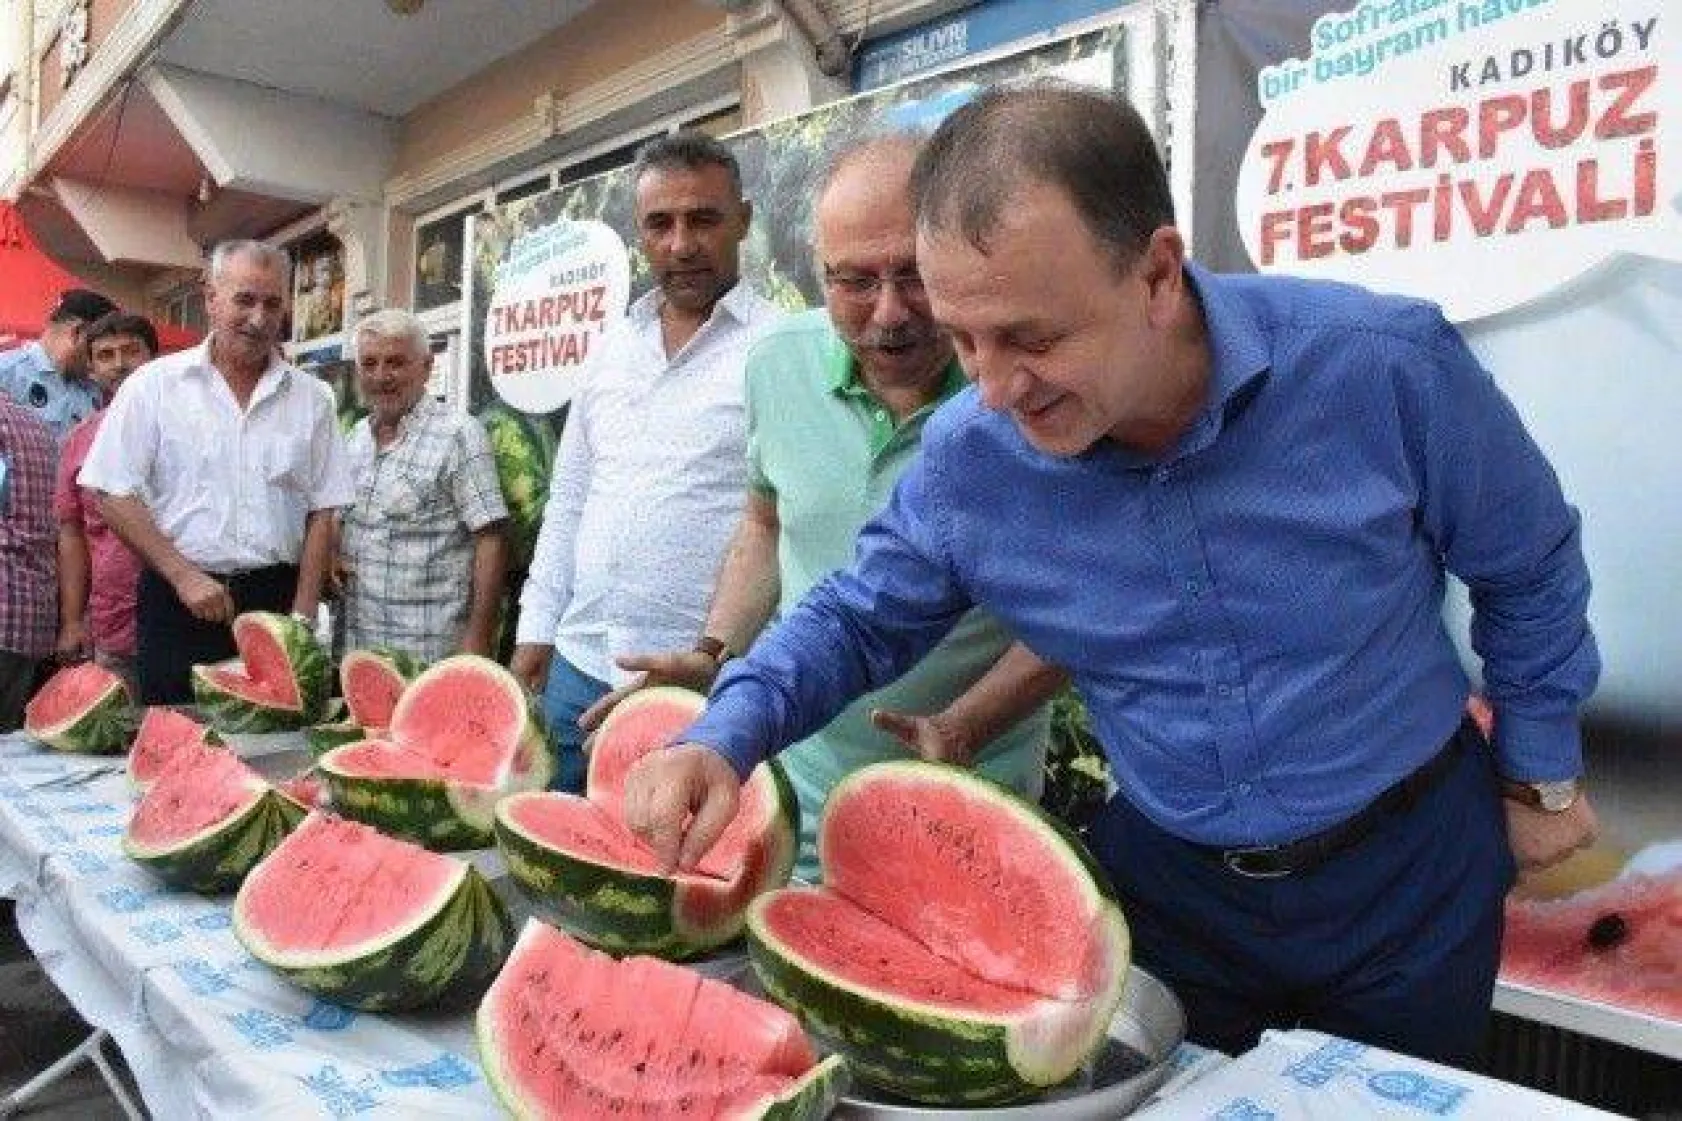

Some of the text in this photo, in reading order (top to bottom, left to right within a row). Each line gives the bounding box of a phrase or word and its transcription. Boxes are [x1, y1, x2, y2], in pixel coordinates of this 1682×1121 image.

[1262, 62, 1306, 101] bir
[1315, 16, 1446, 83] bayram
[1449, 17, 1659, 93] KADIKÖY
[1261, 138, 1658, 267] FESTİVALİ
